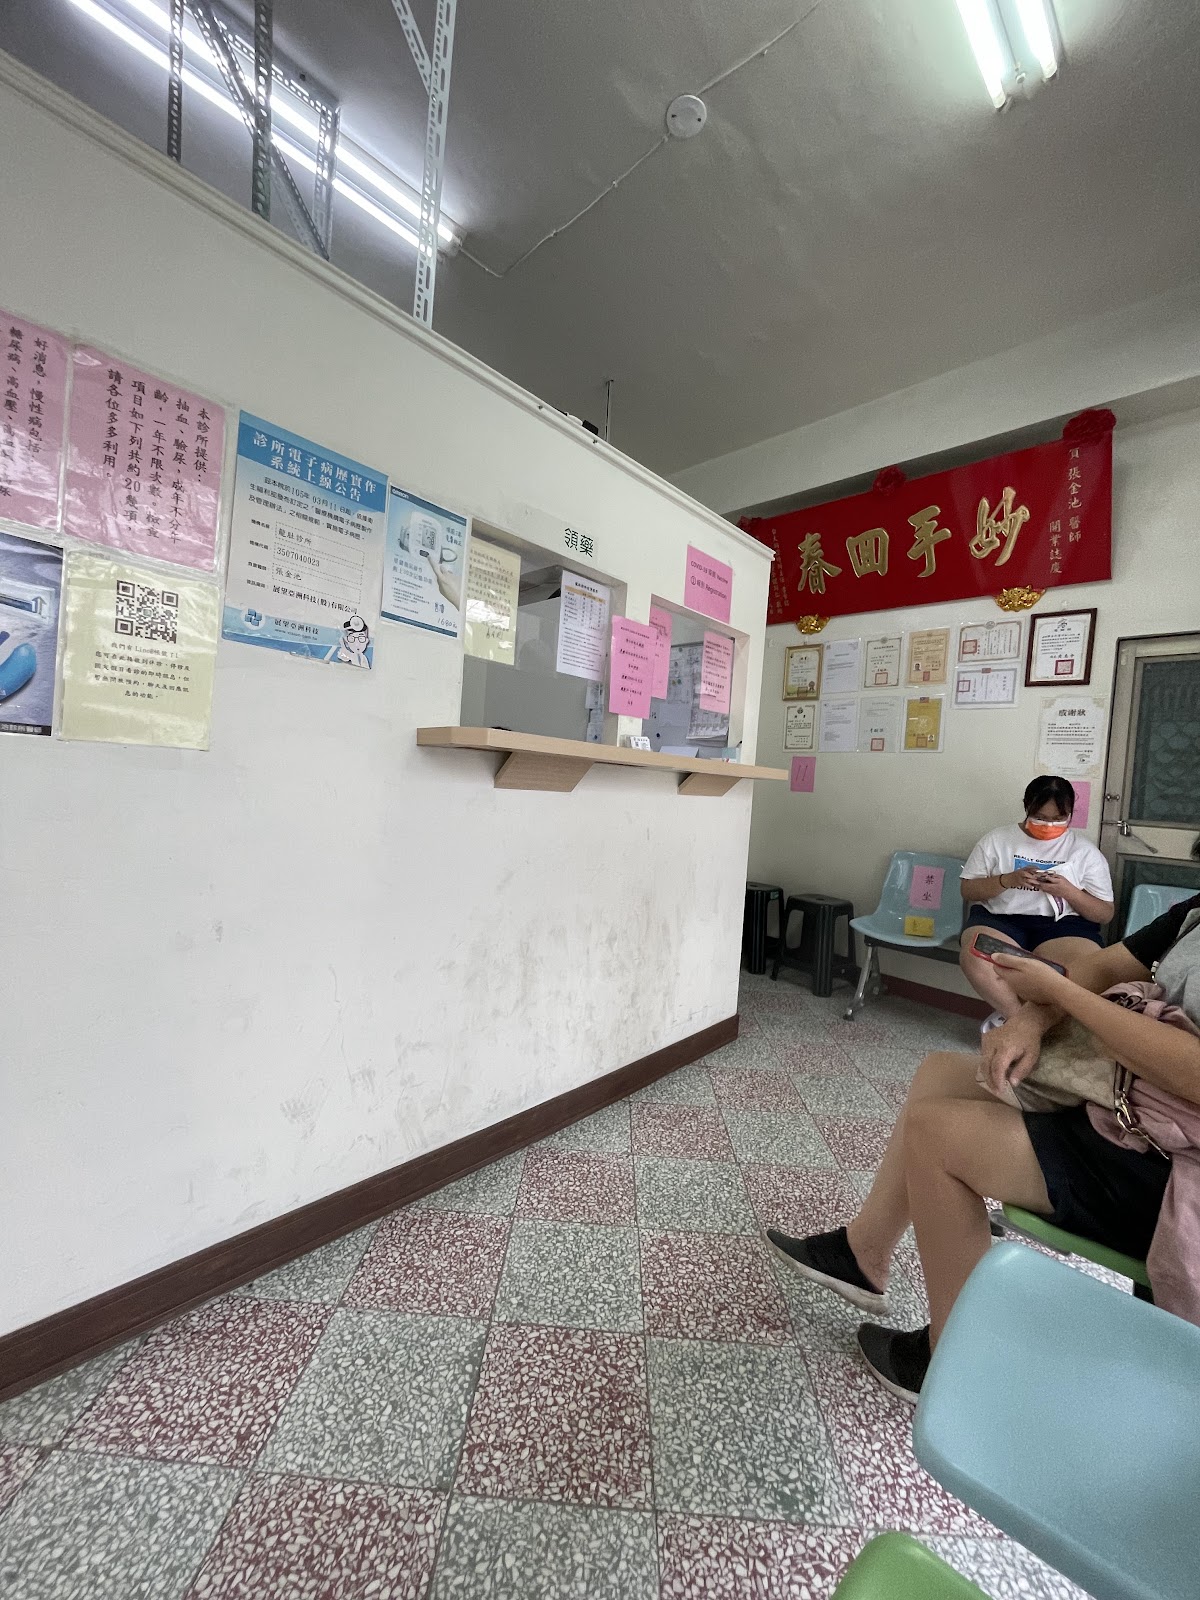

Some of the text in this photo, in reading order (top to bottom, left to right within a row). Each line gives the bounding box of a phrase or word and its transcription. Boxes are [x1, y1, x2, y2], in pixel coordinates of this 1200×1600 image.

[102, 368, 123, 478] 請各位多多利用。
[193, 408, 210, 482] 本診所提供：
[170, 398, 190, 543] 抽血、驗尿，成年不分年
[253, 430, 376, 495] 診所電子病歷實作
[270, 456, 362, 503] 系統上線公告
[564, 526, 594, 558] 領藥
[1058, 708, 1086, 717] 感謝狀
[921, 874, 935, 902] 禁坐
